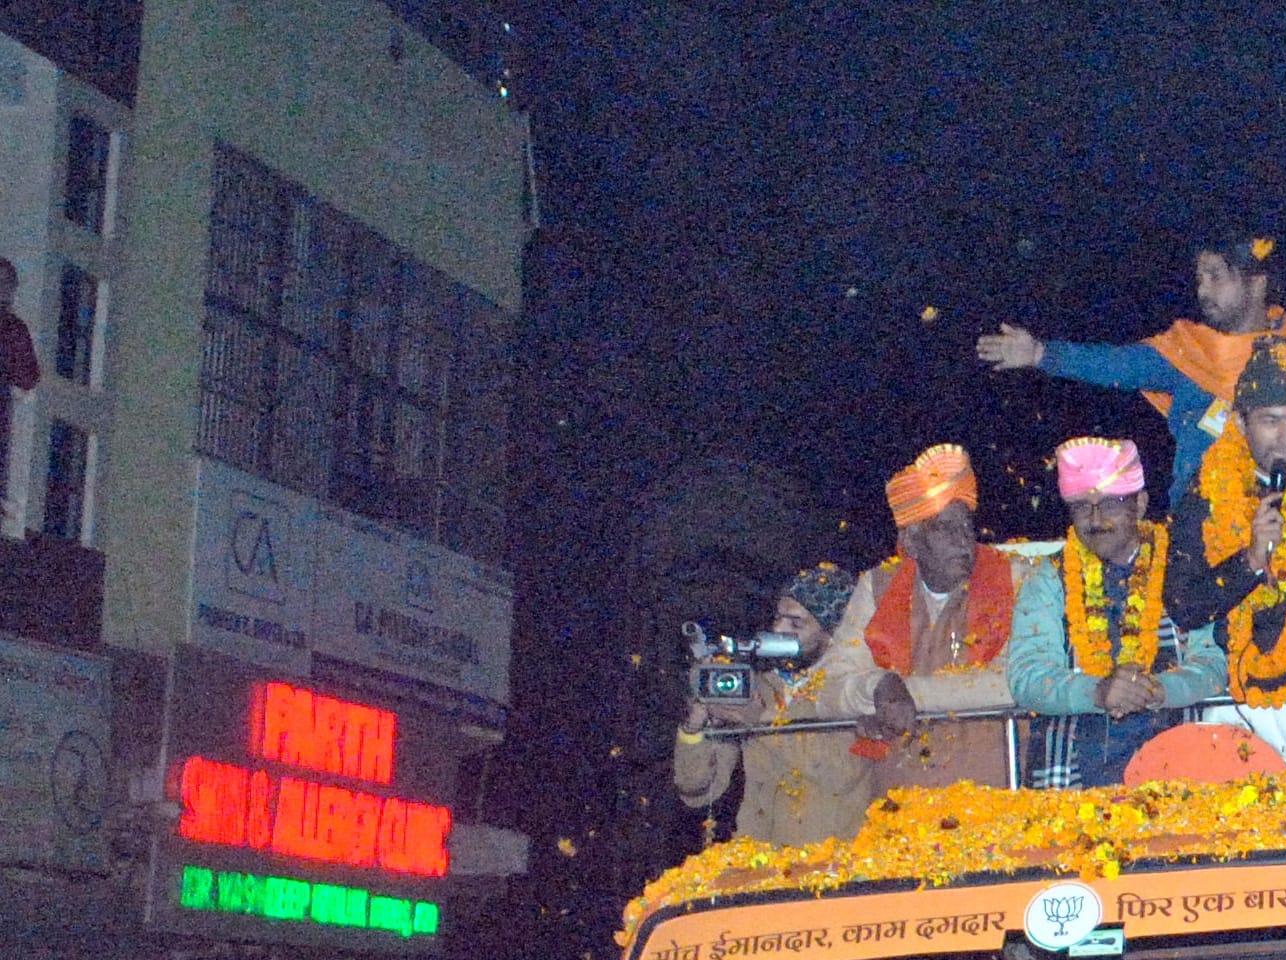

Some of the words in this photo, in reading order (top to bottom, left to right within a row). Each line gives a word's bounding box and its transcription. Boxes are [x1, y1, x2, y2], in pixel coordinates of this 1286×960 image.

[262, 682, 397, 785] PARTH
[1116, 892, 1173, 920] फिर
[1182, 892, 1235, 922] एक
[842, 919, 907, 946] काम
[916, 911, 1007, 938] दमदार
